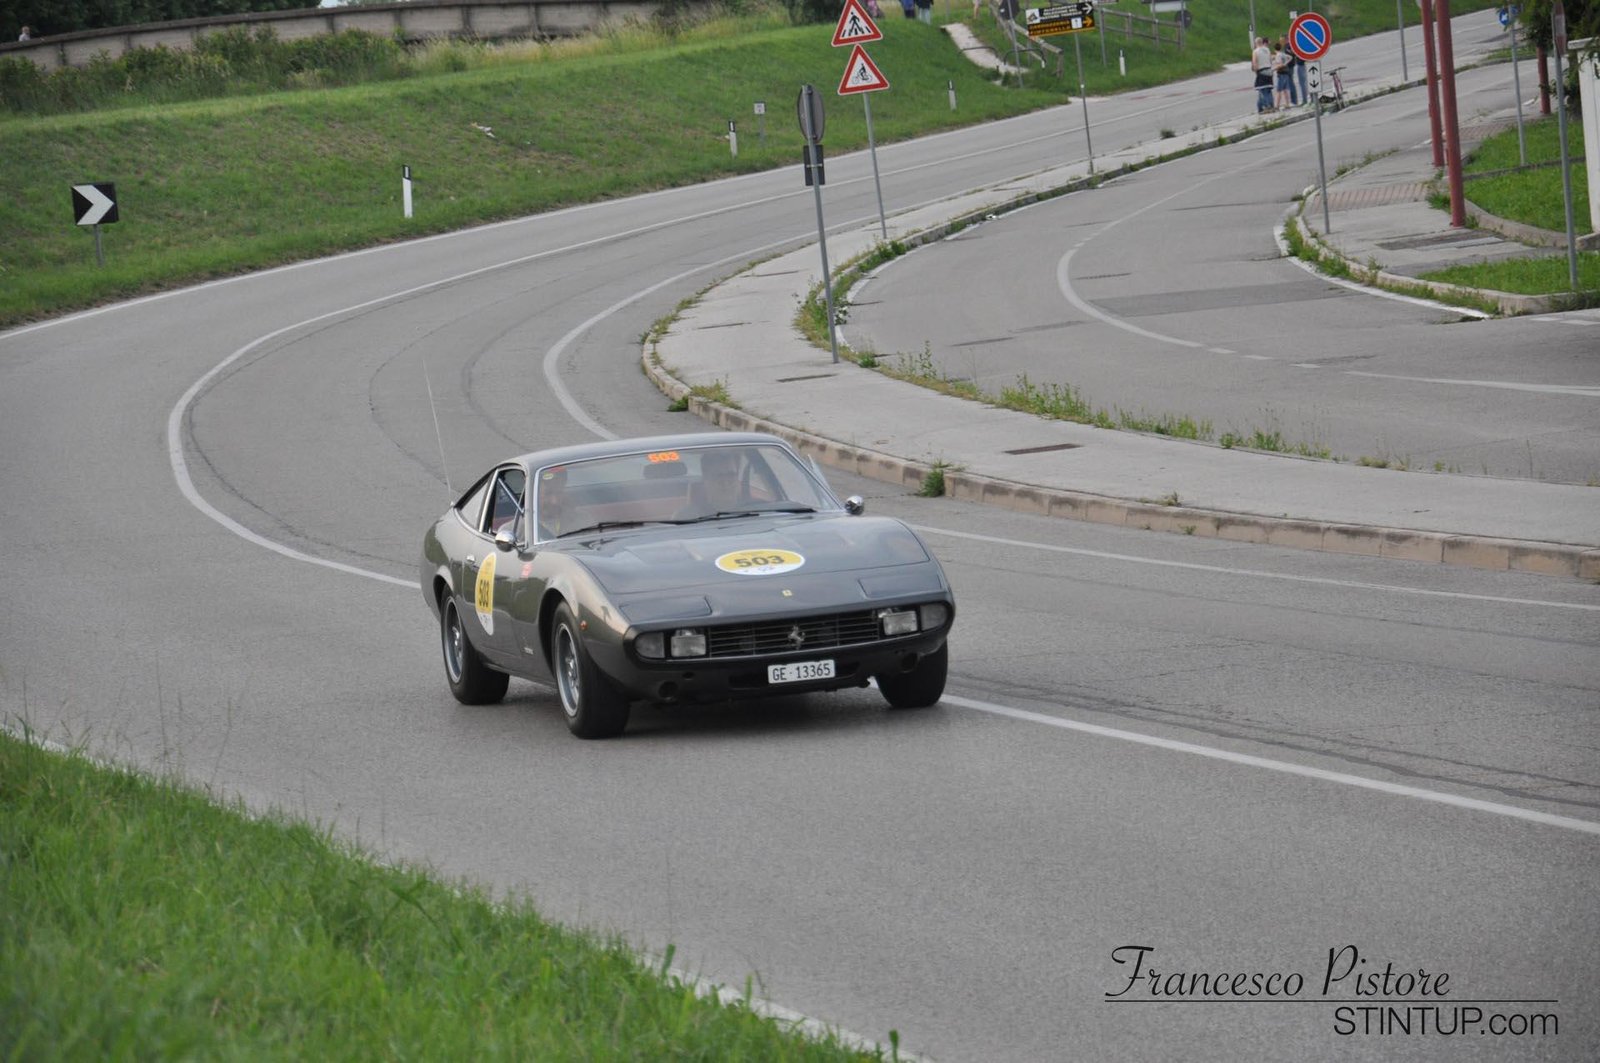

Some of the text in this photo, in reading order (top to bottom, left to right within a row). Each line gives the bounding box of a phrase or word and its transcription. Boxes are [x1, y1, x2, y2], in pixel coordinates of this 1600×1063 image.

[648, 451, 680, 464] 503
[734, 555, 785, 568] 503
[479, 579, 490, 608] 503
[796, 663, 832, 679] 13365
